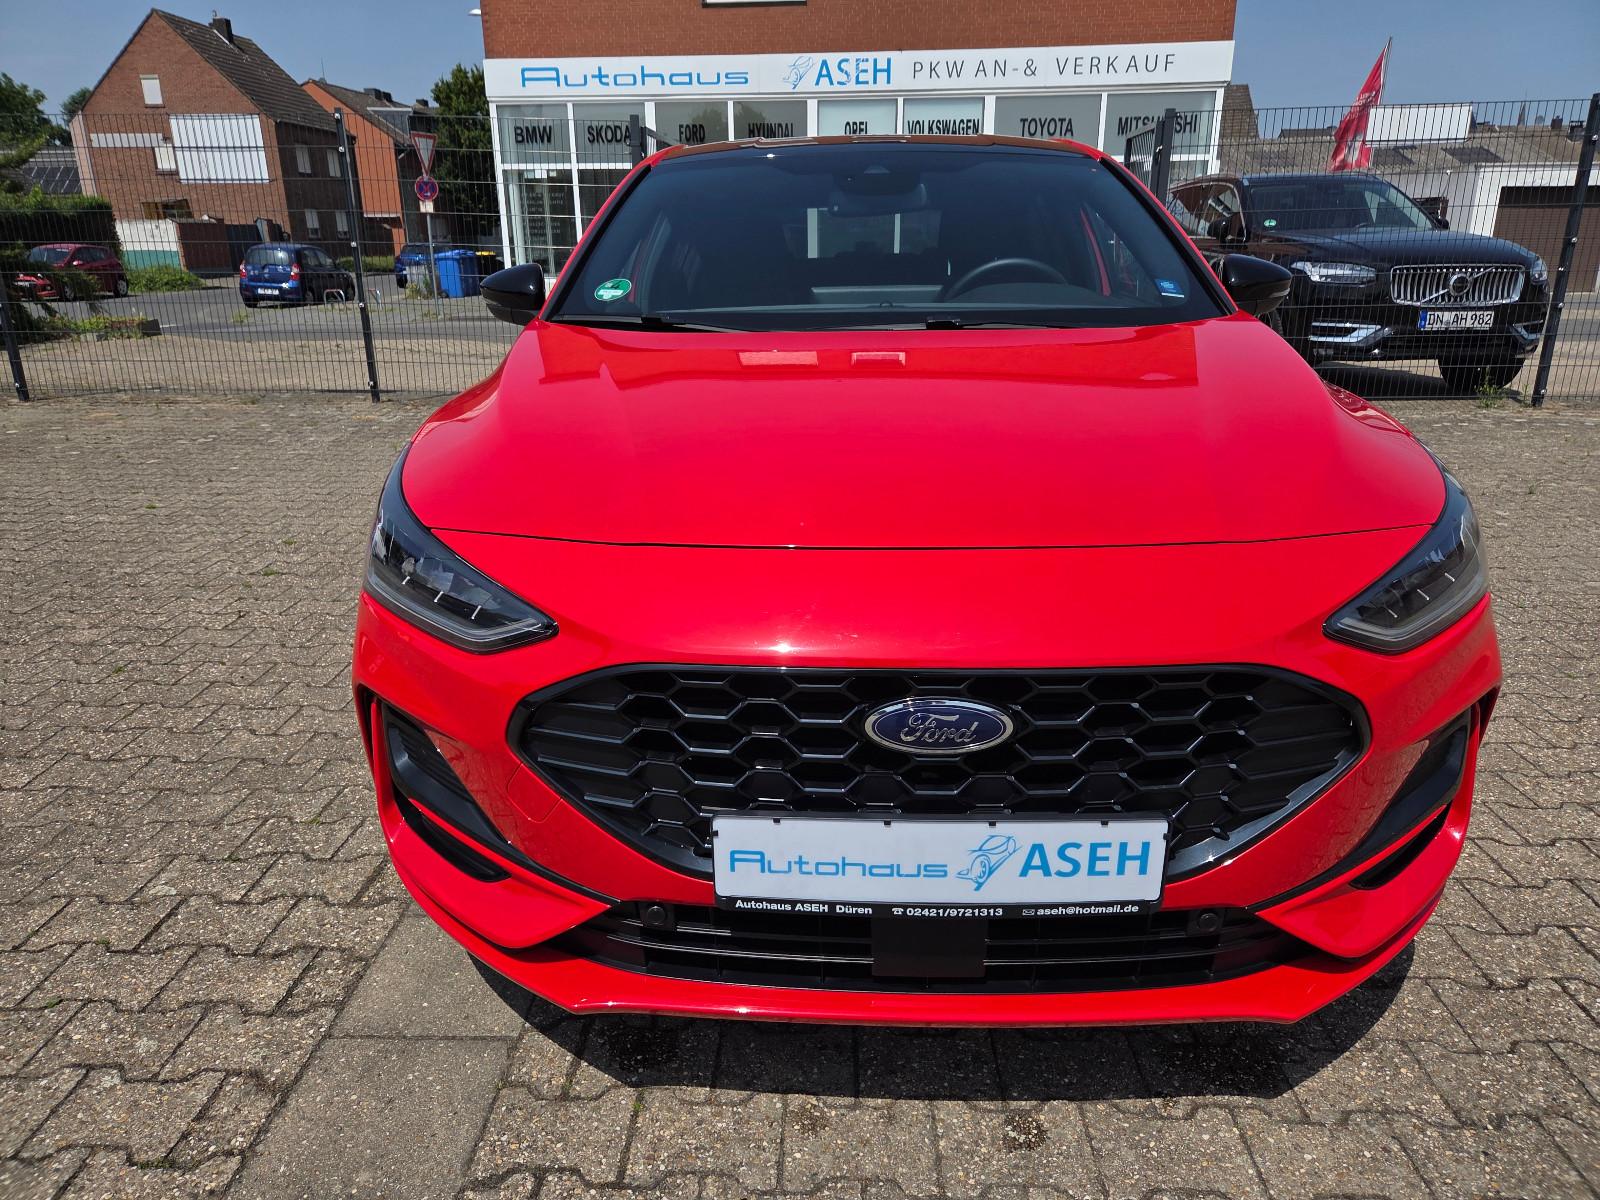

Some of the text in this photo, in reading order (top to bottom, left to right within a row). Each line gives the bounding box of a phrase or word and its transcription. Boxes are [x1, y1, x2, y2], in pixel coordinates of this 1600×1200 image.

[520, 65, 749, 88] Autohaus
[814, 57, 892, 87] ASEH
[912, 59, 967, 80] PKW
[1055, 53, 1177, 76] VERKAUF
[514, 125, 553, 144] BMW
[678, 124, 706, 142] FORD
[1019, 117, 1074, 137] TOYOTA
[1428, 313, 1493, 326] DN AH 982
[900, 713, 979, 742] Ford
[729, 841, 1151, 879] Autohaus ASEH
[735, 899, 1139, 917] Autohaus ASEH Düren 02421/9721313 aseh@hotmail.de
